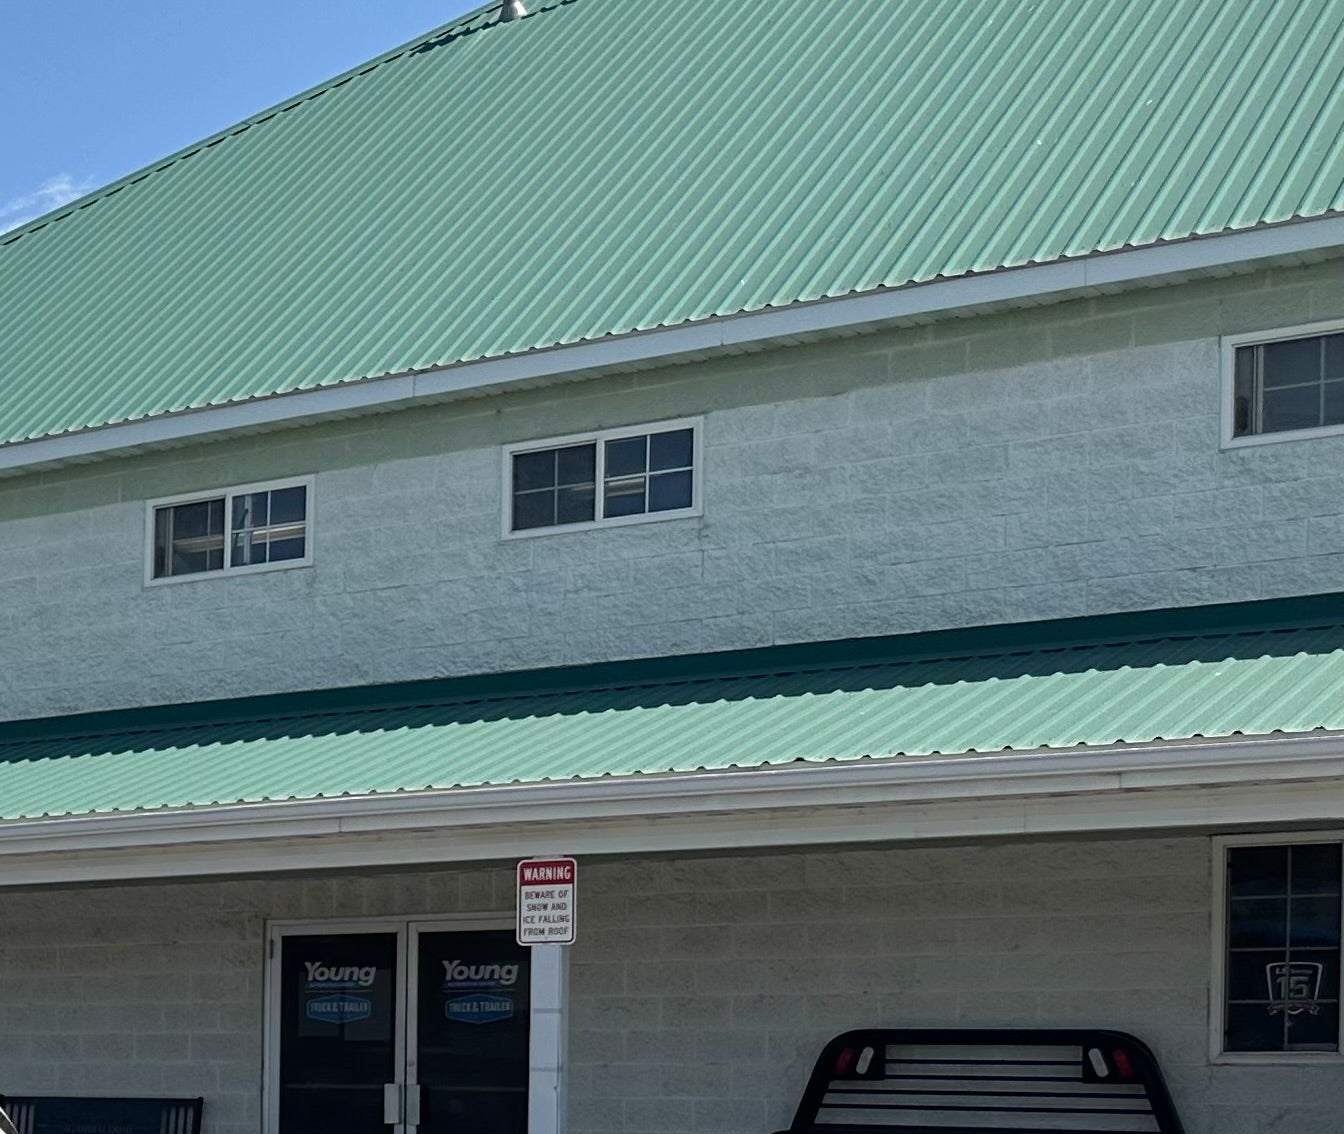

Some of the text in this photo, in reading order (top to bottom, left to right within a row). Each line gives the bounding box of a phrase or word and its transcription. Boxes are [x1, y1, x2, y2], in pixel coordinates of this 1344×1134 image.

[523, 865, 572, 882] WARNING
[524, 889, 569, 900] BEWARE OF
[526, 902, 568, 912] SNOW AND
[523, 914, 570, 924] ICE FALLING
[523, 926, 569, 937] FROM ROOF
[304, 961, 377, 987] Young
[441, 960, 519, 985] Young
[1276, 976, 1310, 998] 15
[449, 1001, 510, 1013] TRUCK & TRAILER
